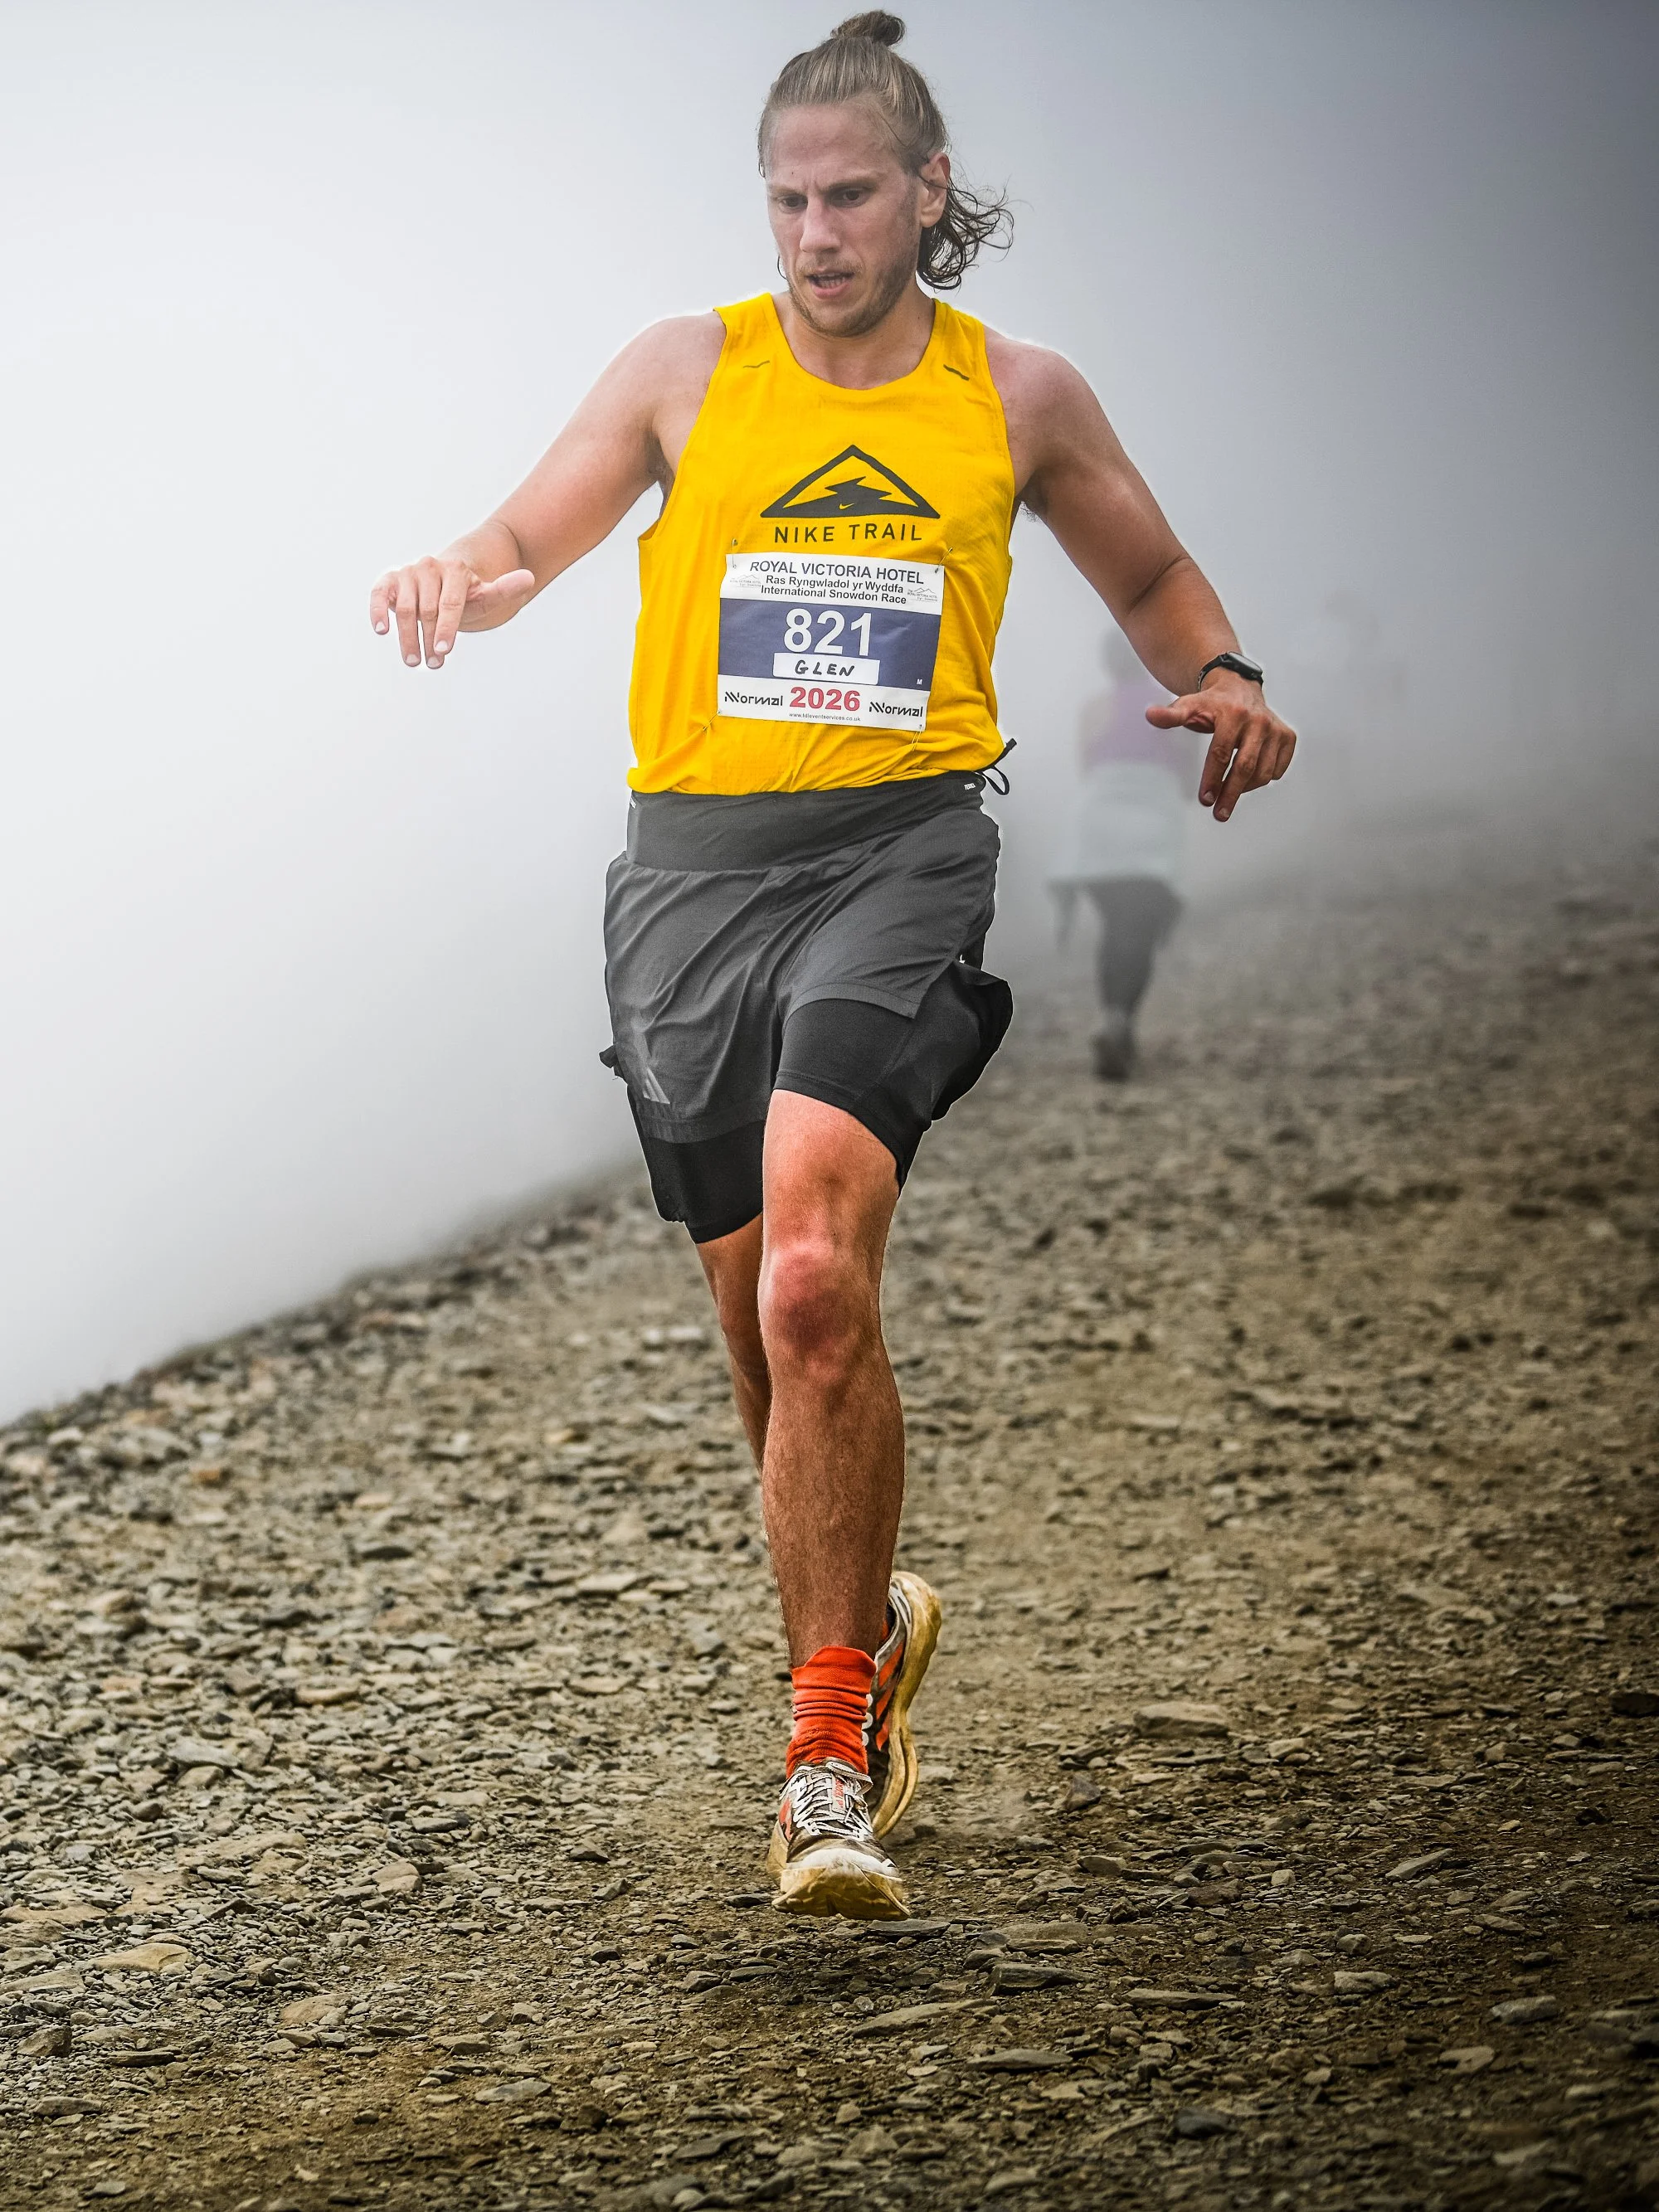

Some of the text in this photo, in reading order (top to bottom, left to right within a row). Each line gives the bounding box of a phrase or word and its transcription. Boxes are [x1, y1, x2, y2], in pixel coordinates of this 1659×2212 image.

[774, 523, 922, 543] NIKE TRAIL
[750, 561, 924, 585] ROYAL VICTORIA HOTEL
[761, 585, 907, 605] International Snowdon Race
[766, 575, 786, 585] Ras
[789, 576, 849, 590] Ryngwladol
[852, 582, 864, 591] yr
[864, 581, 904, 595] Wyddfa
[784, 608, 872, 656] 821
[795, 659, 855, 677] GLEN
[789, 686, 861, 712] 2026
